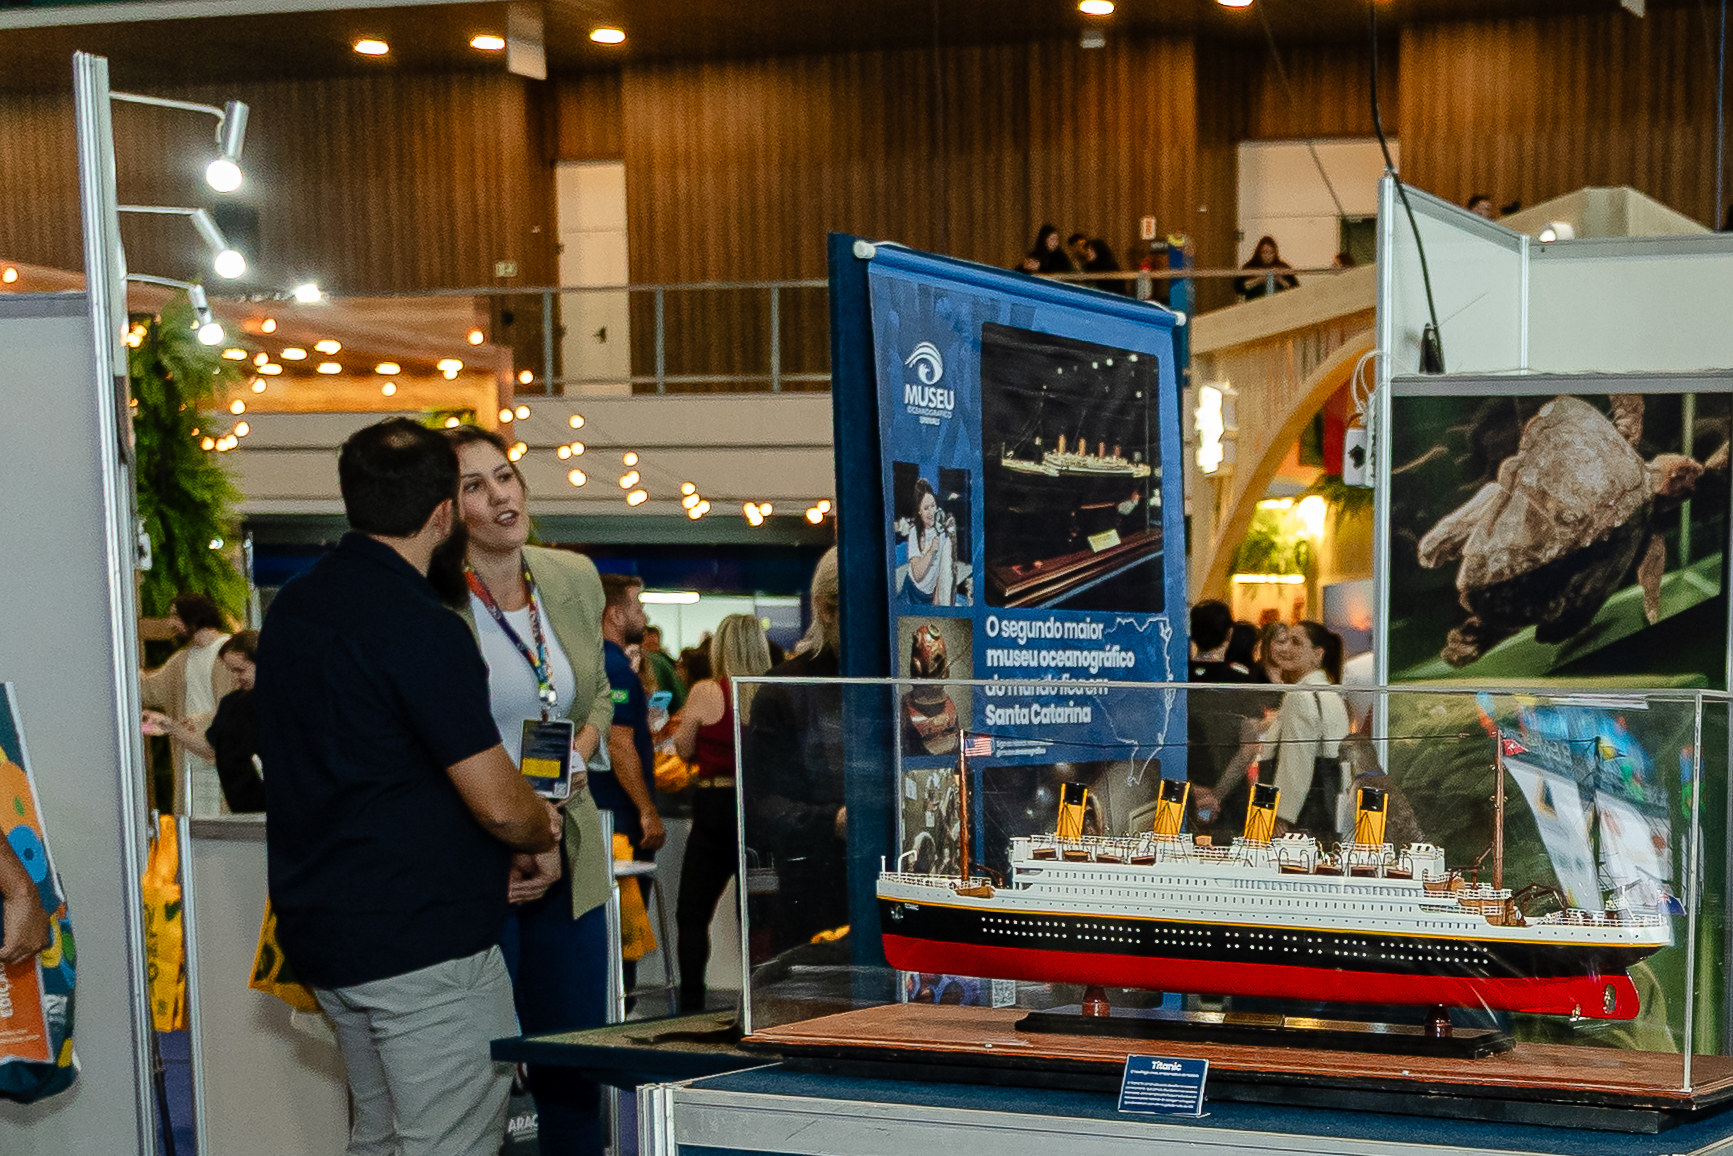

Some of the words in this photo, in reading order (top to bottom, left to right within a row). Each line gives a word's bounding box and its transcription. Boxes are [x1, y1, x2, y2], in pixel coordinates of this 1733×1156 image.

[904, 384, 955, 410] MUSEU
[985, 615, 999, 638] O
[1001, 616, 1063, 645] segundo
[1064, 617, 1104, 640] maior
[986, 648, 1038, 668] museu
[1039, 644, 1136, 674] oceanográfico
[985, 674, 1005, 696] do
[1006, 674, 1058, 696] mundo
[985, 703, 1029, 726] Santa
[1030, 700, 1092, 725] Catarina
[1151, 1060, 1182, 1071] Titanic
